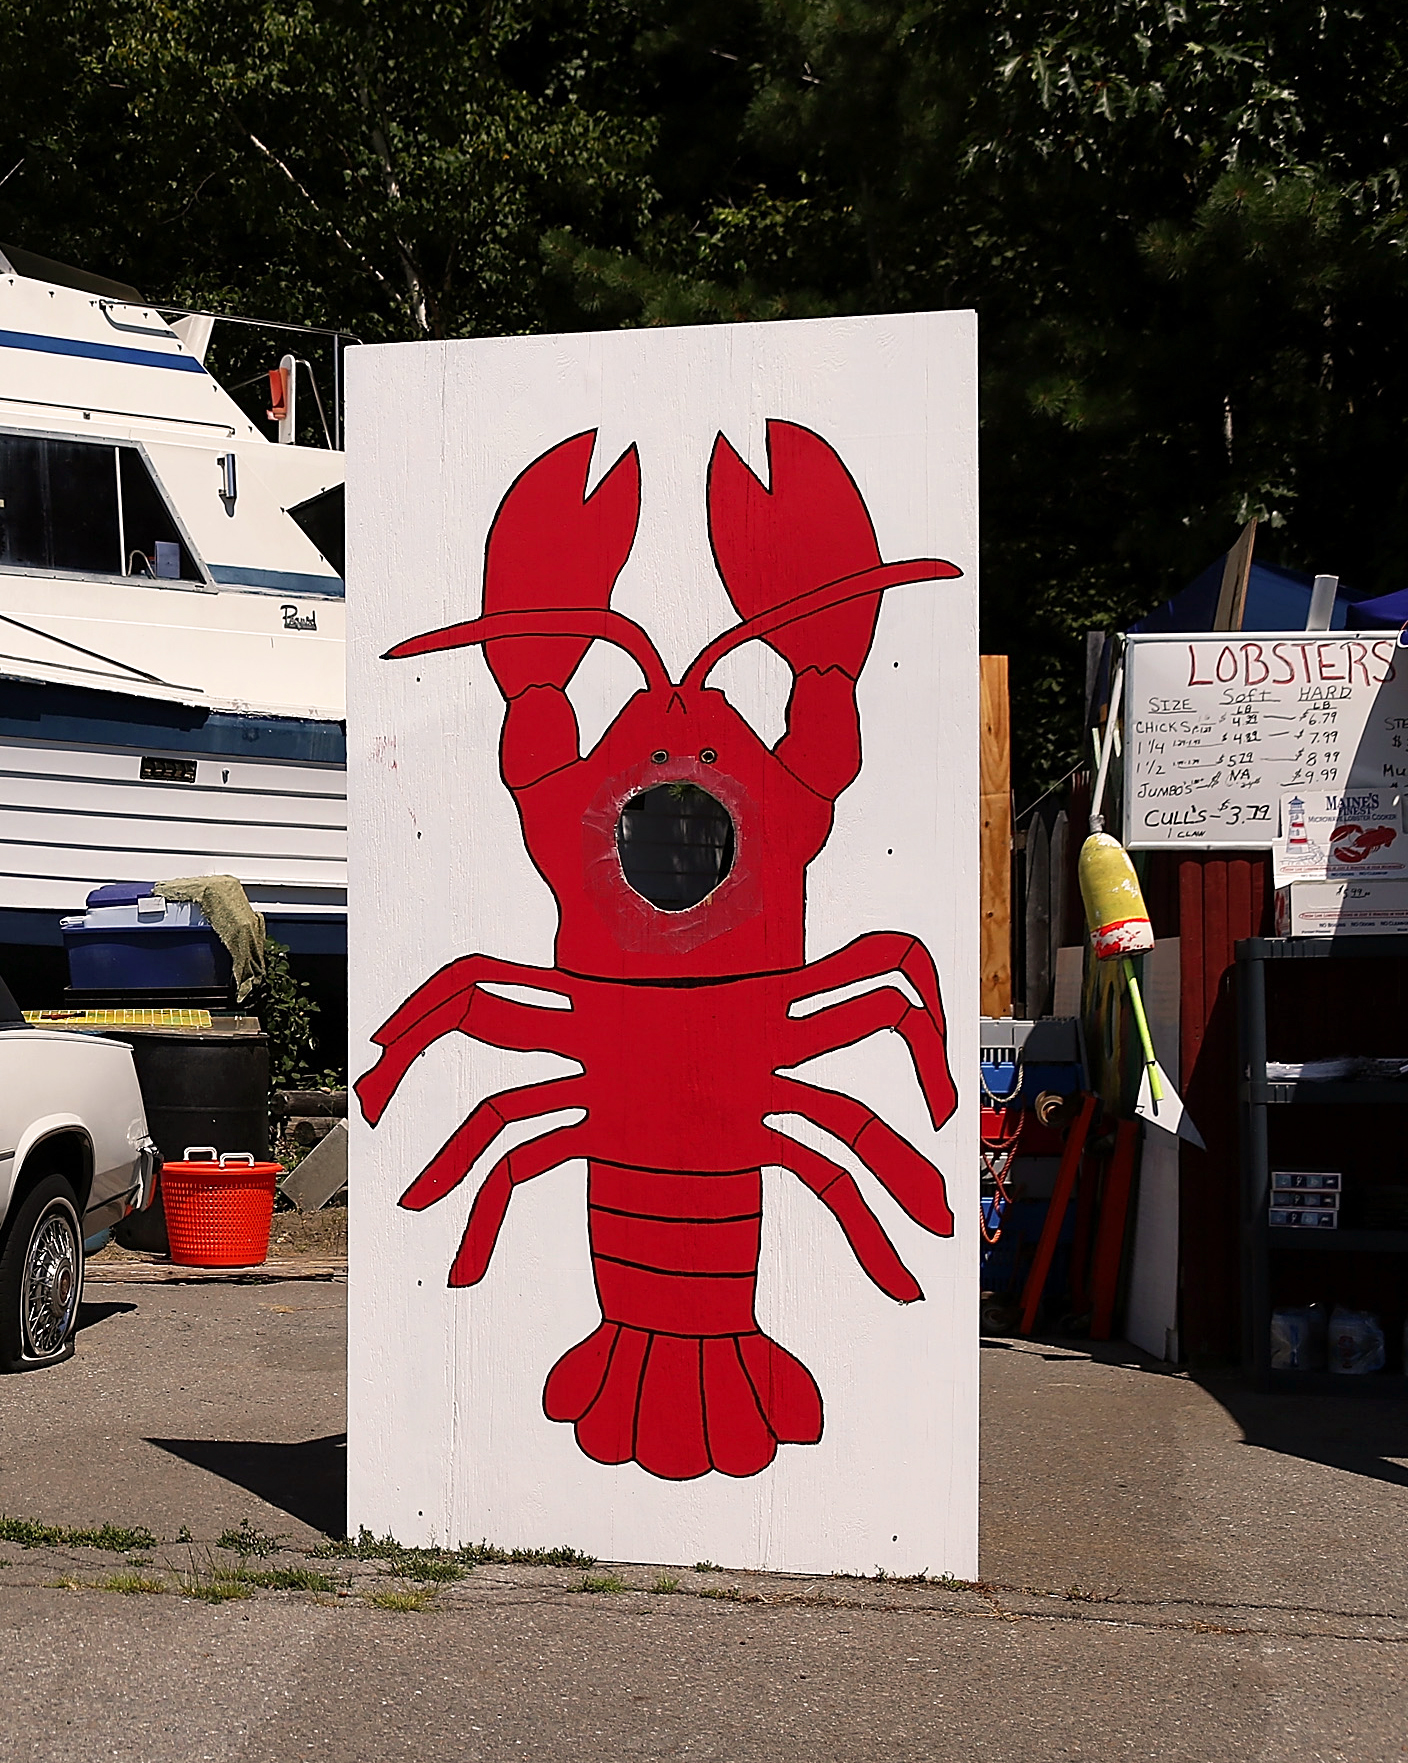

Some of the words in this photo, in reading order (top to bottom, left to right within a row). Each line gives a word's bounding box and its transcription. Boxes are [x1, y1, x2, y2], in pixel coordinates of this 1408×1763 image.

[1188, 641, 1396, 687] LOBSTERS
[1299, 686, 1352, 700] HARD
[1148, 697, 1193, 712] SIZE
[1237, 704, 1252, 714] LB
[1313, 701, 1331, 710] LB
[1135, 720, 1191, 734] CHICKS
[1229, 768, 1251, 781] NA
[1325, 793, 1380, 810] MAINE'S
[1177, 830, 1207, 839] CLAW
